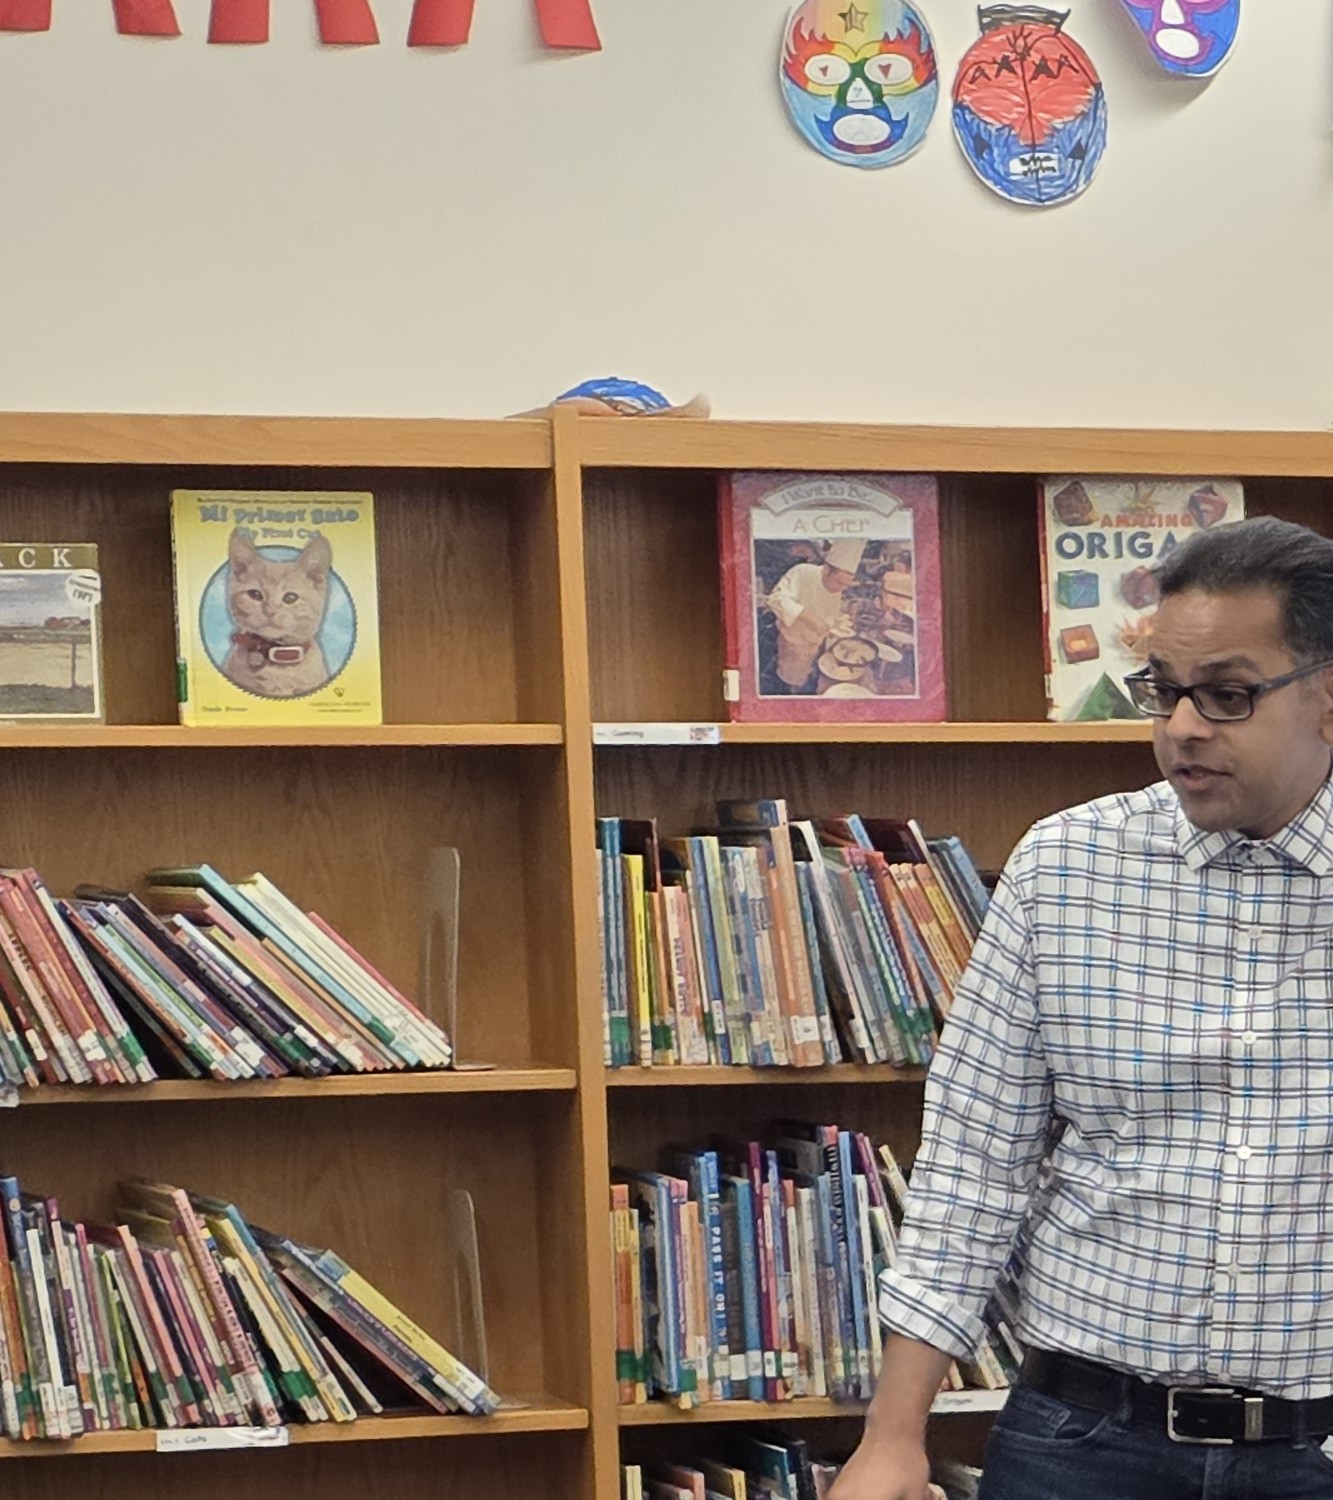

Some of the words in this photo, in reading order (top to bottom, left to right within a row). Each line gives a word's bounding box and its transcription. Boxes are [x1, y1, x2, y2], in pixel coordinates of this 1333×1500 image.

[1100, 513, 1194, 528] AMAZING
[1055, 531, 1179, 560] ORIGA
[0, 548, 73, 568] CK
